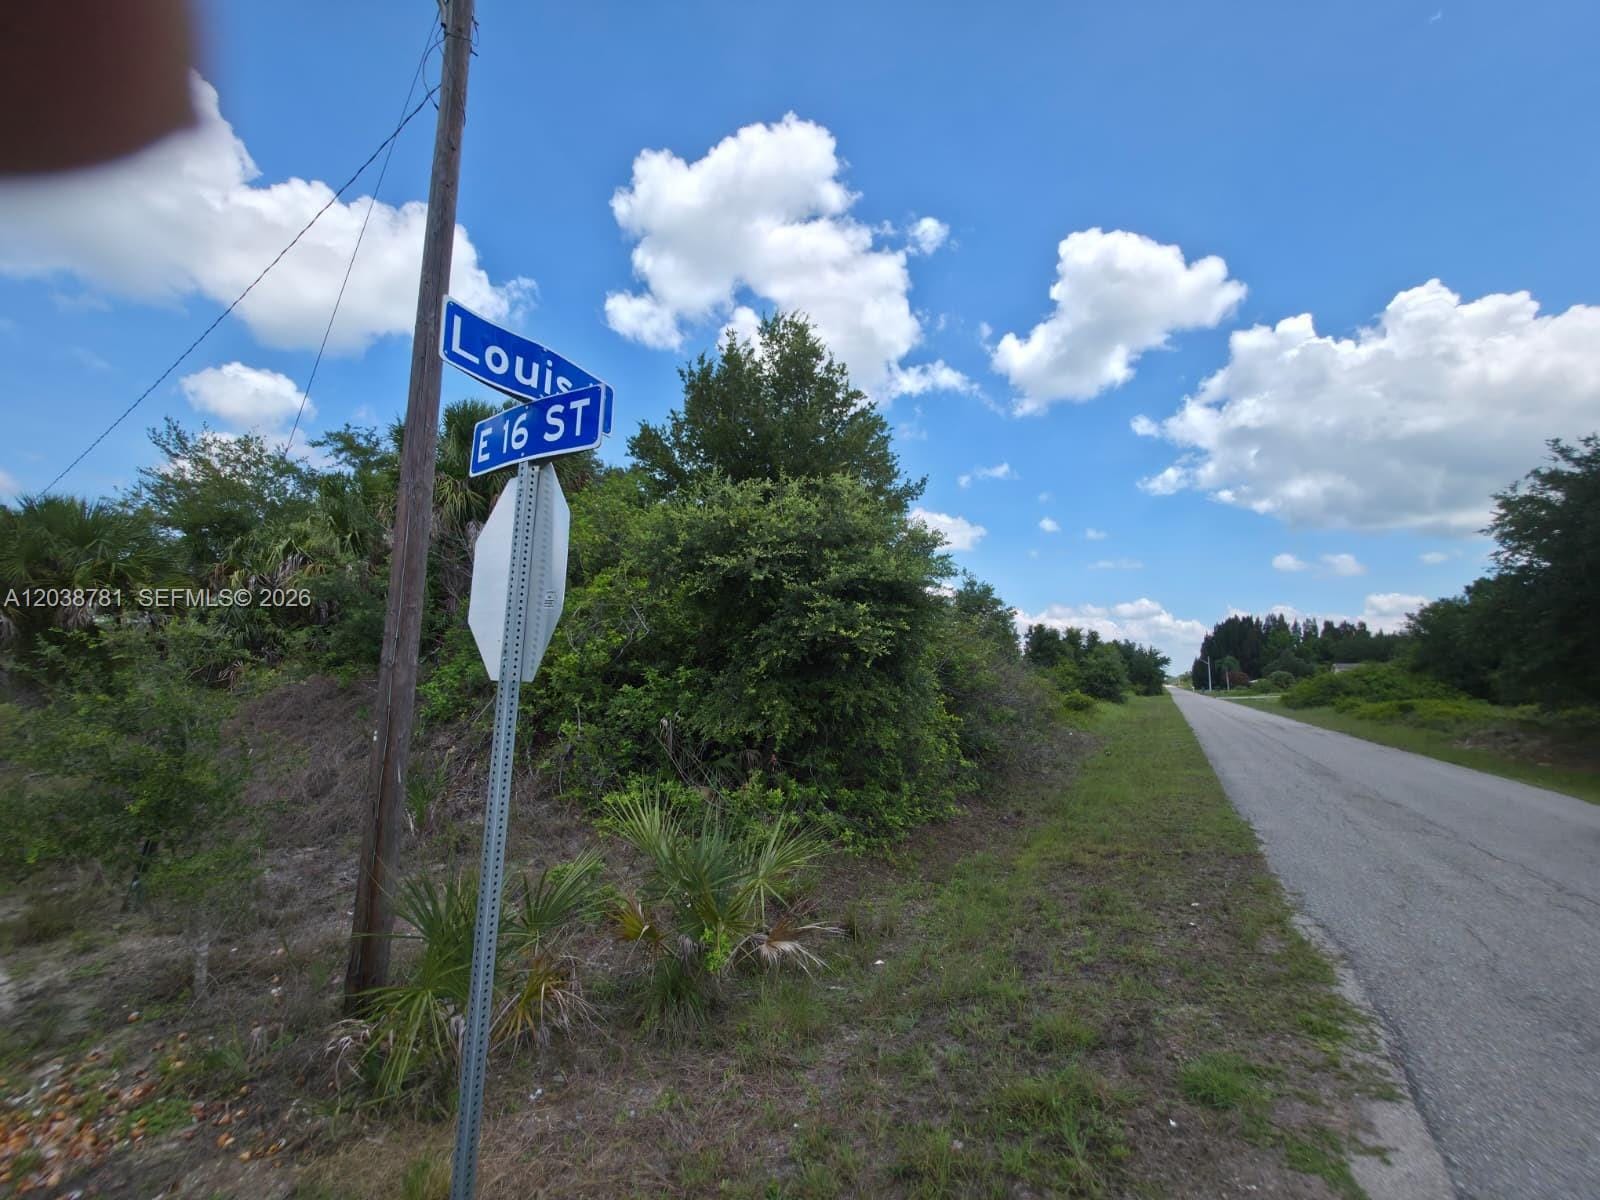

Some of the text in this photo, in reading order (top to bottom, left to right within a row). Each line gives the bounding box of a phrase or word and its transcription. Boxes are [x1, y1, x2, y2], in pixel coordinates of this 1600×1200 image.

[477, 398, 591, 464] E 16 ST
